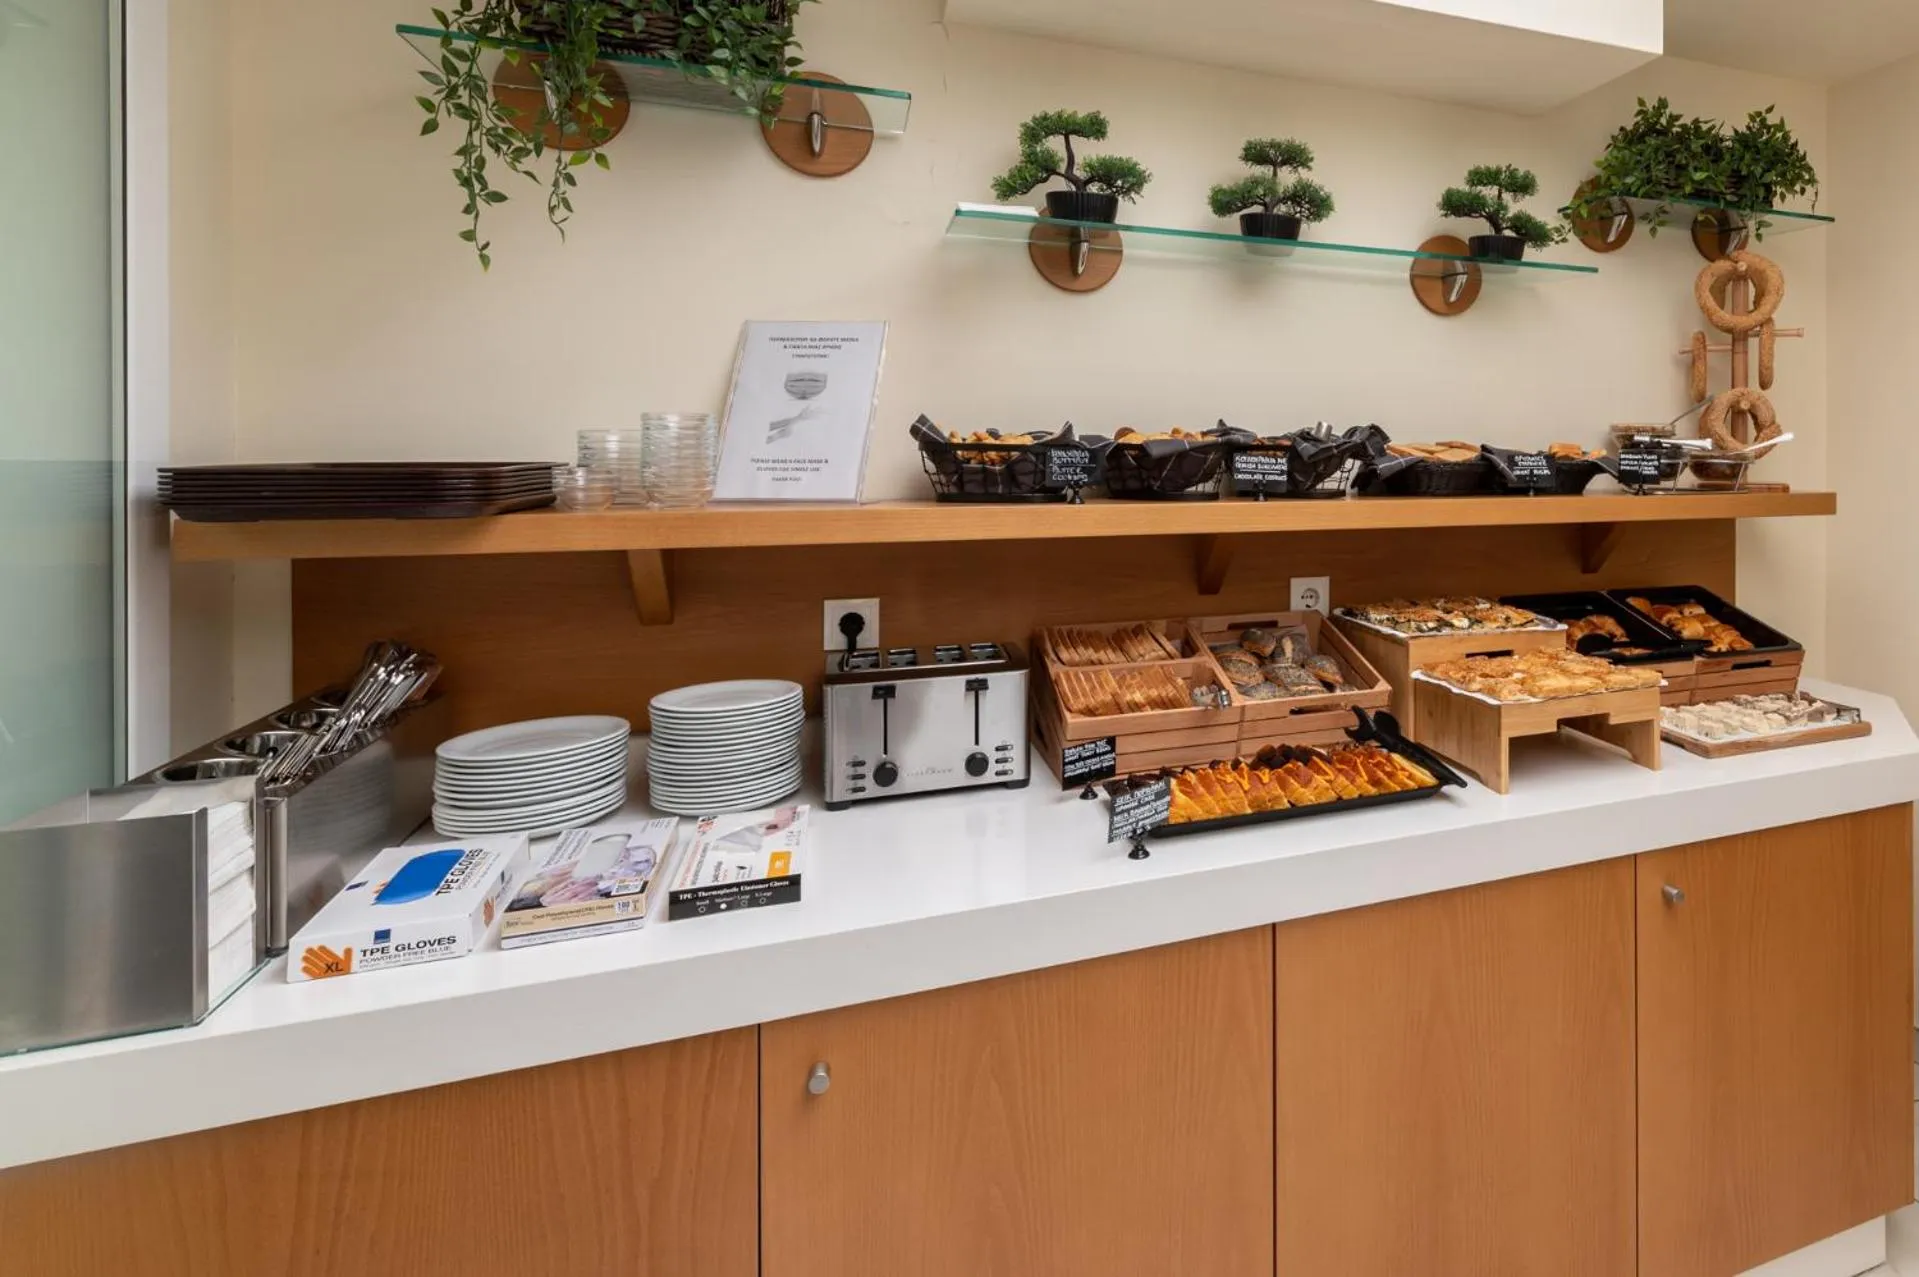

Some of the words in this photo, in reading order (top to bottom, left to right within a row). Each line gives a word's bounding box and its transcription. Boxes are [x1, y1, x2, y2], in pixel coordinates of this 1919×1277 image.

[435, 878, 459, 896] TPE
[451, 848, 484, 877] GLOVES
[359, 945, 390, 958] TPE
[394, 936, 457, 952] GLOVES
[359, 953, 402, 964] POWDER
[324, 961, 344, 974] XL
